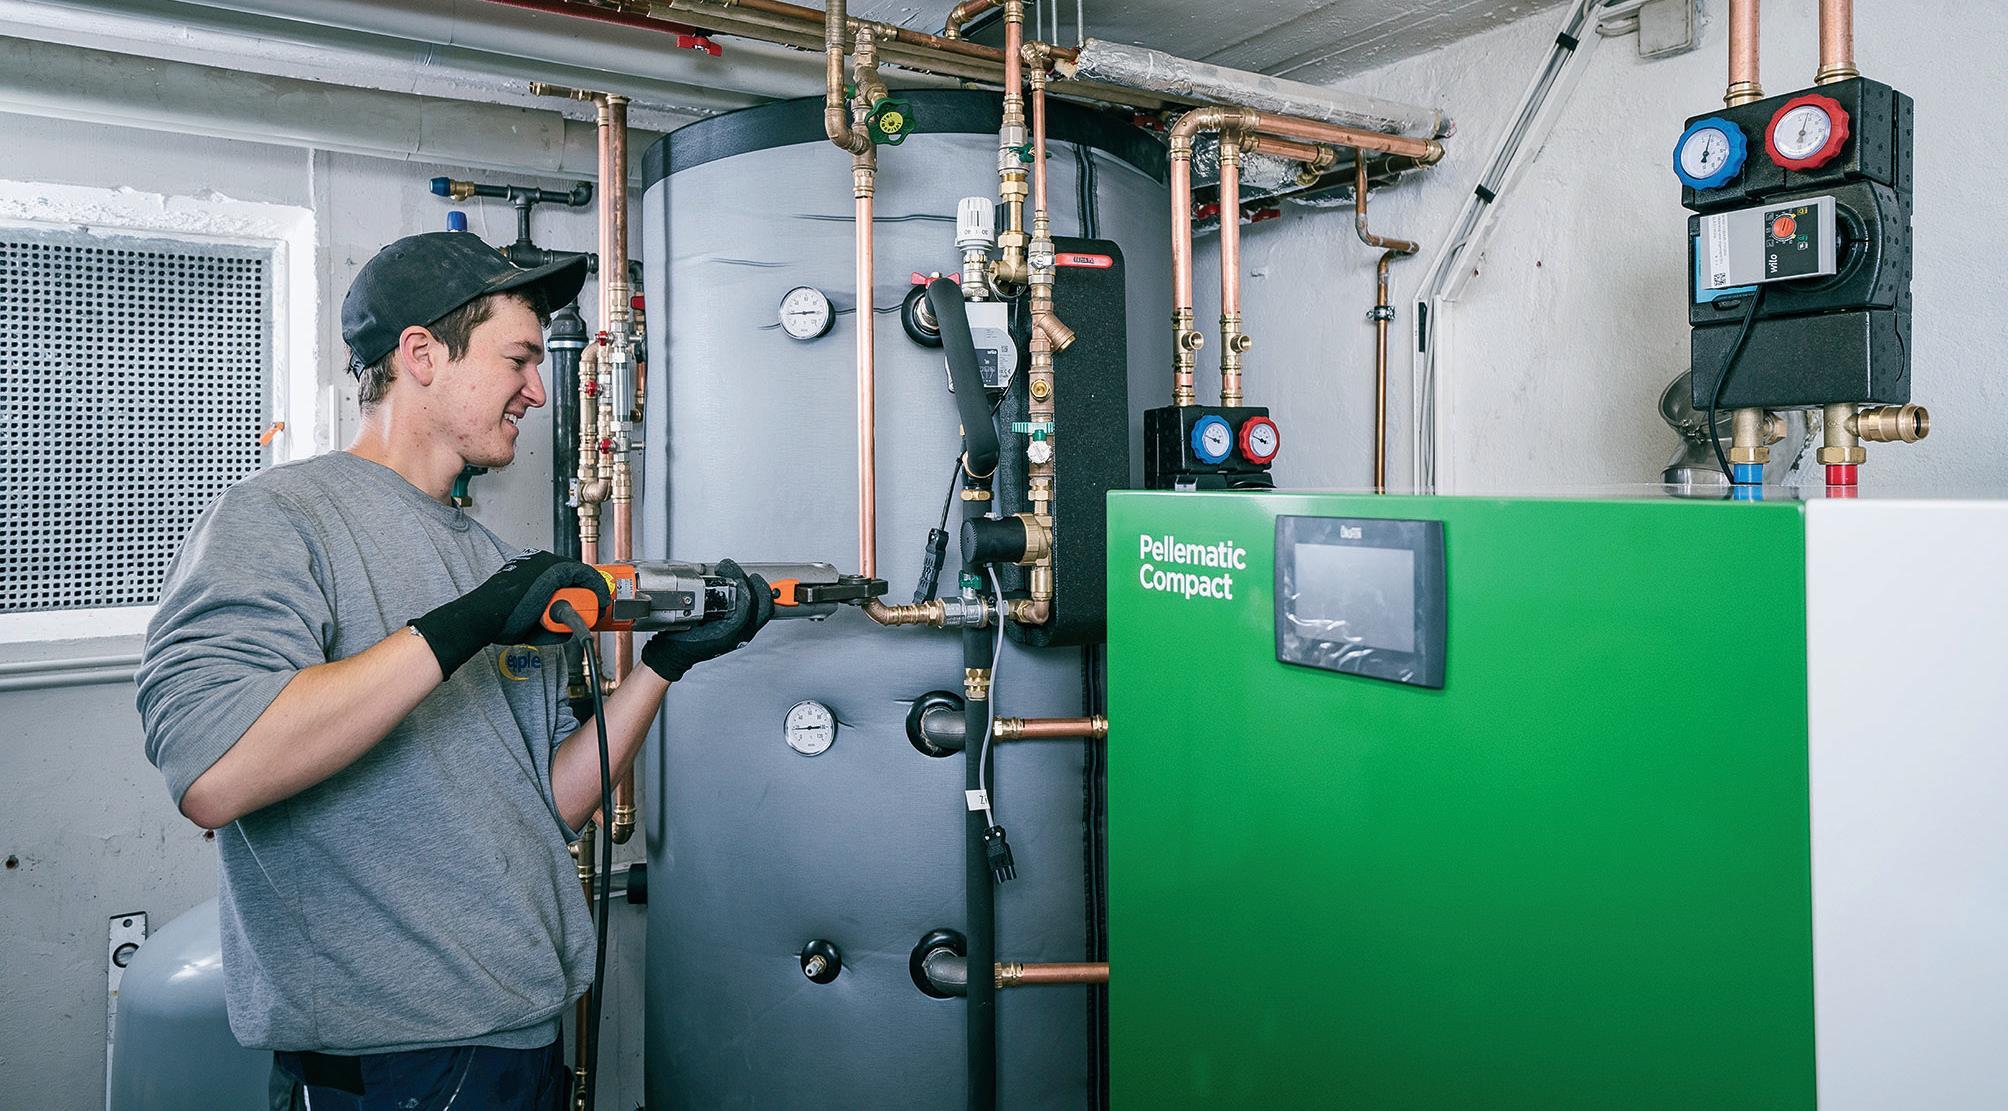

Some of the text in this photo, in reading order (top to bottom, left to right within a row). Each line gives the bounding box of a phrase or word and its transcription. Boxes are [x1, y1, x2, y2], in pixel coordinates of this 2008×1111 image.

[1768, 254, 1778, 273] wilo
[1140, 534, 1246, 570] Pellematic
[1139, 563, 1233, 600] Compact
